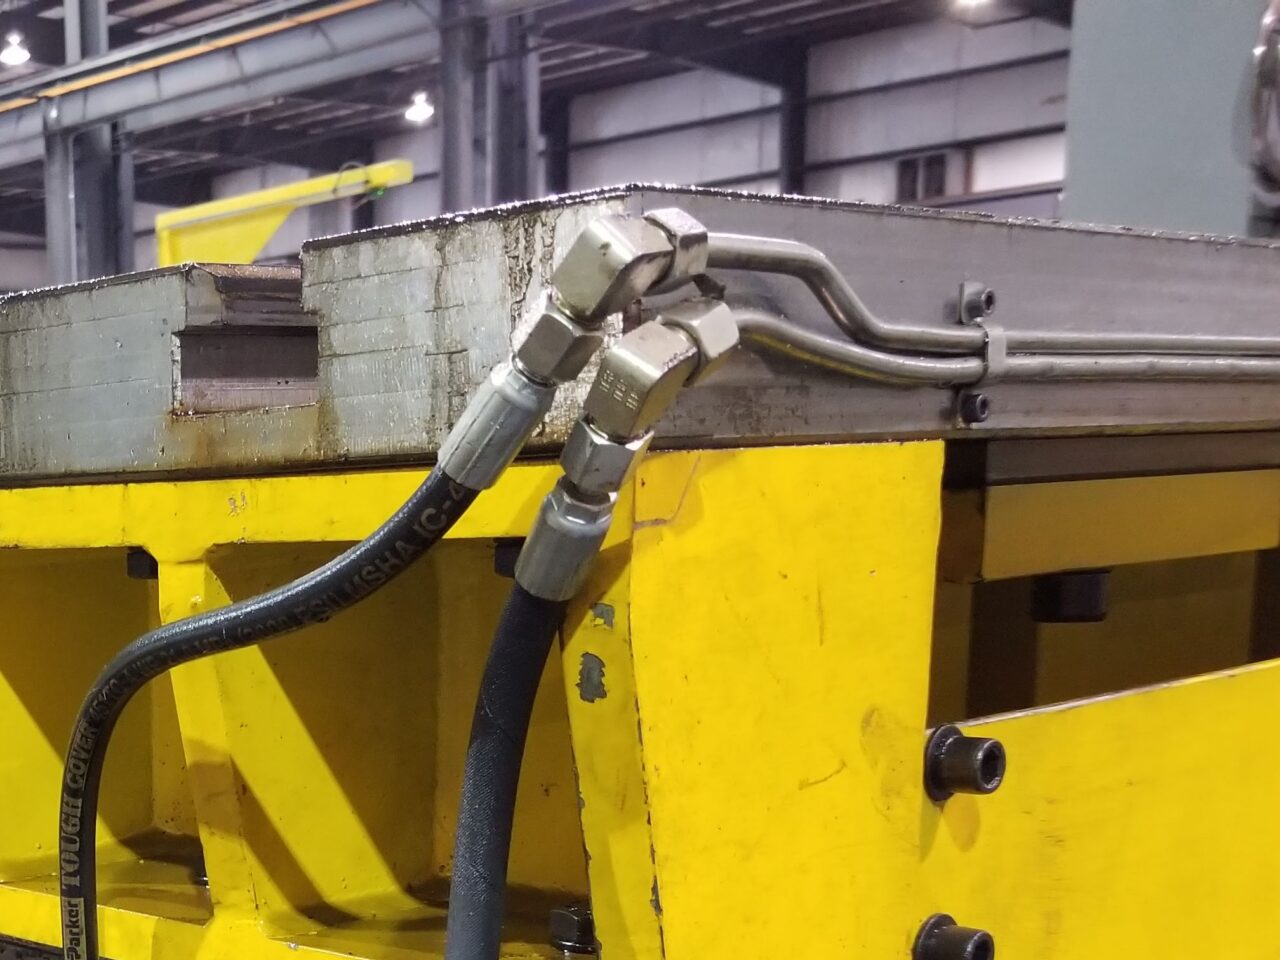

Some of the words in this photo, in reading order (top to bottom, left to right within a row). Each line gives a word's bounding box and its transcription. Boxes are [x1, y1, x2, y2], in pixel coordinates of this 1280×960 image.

[342, 541, 424, 600] MSHA
[67, 719, 98, 789] COVER
[61, 793, 82, 890] TOUGH
